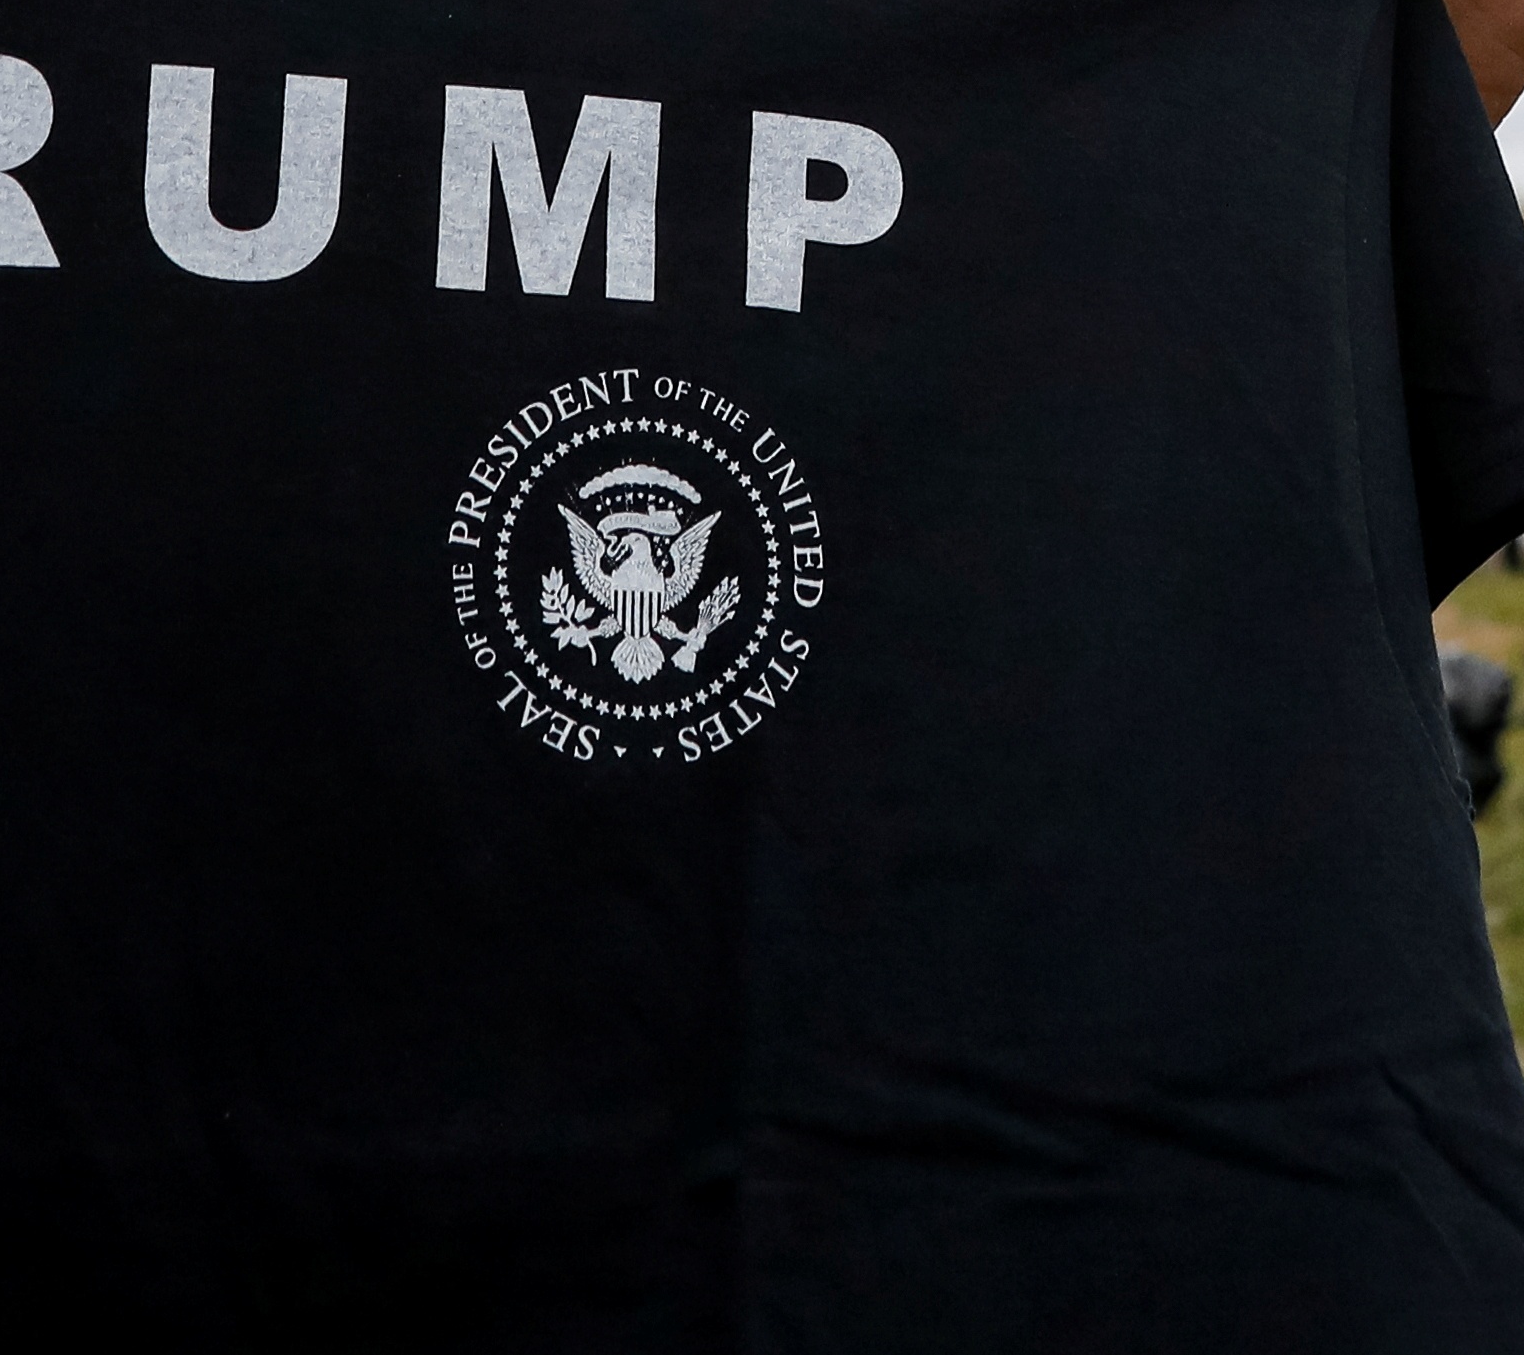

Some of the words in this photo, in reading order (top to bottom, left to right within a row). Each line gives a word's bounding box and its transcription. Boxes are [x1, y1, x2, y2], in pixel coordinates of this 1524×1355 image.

[654, 376, 692, 401] OF
[699, 387, 750, 433] THE
[448, 368, 640, 549] PRESIDENT
[752, 427, 824, 608] UNITED
[452, 562, 479, 626] THE
[464, 632, 497, 670] OF
[496, 670, 601, 761] SEAL
[677, 628, 810, 763] STATES
